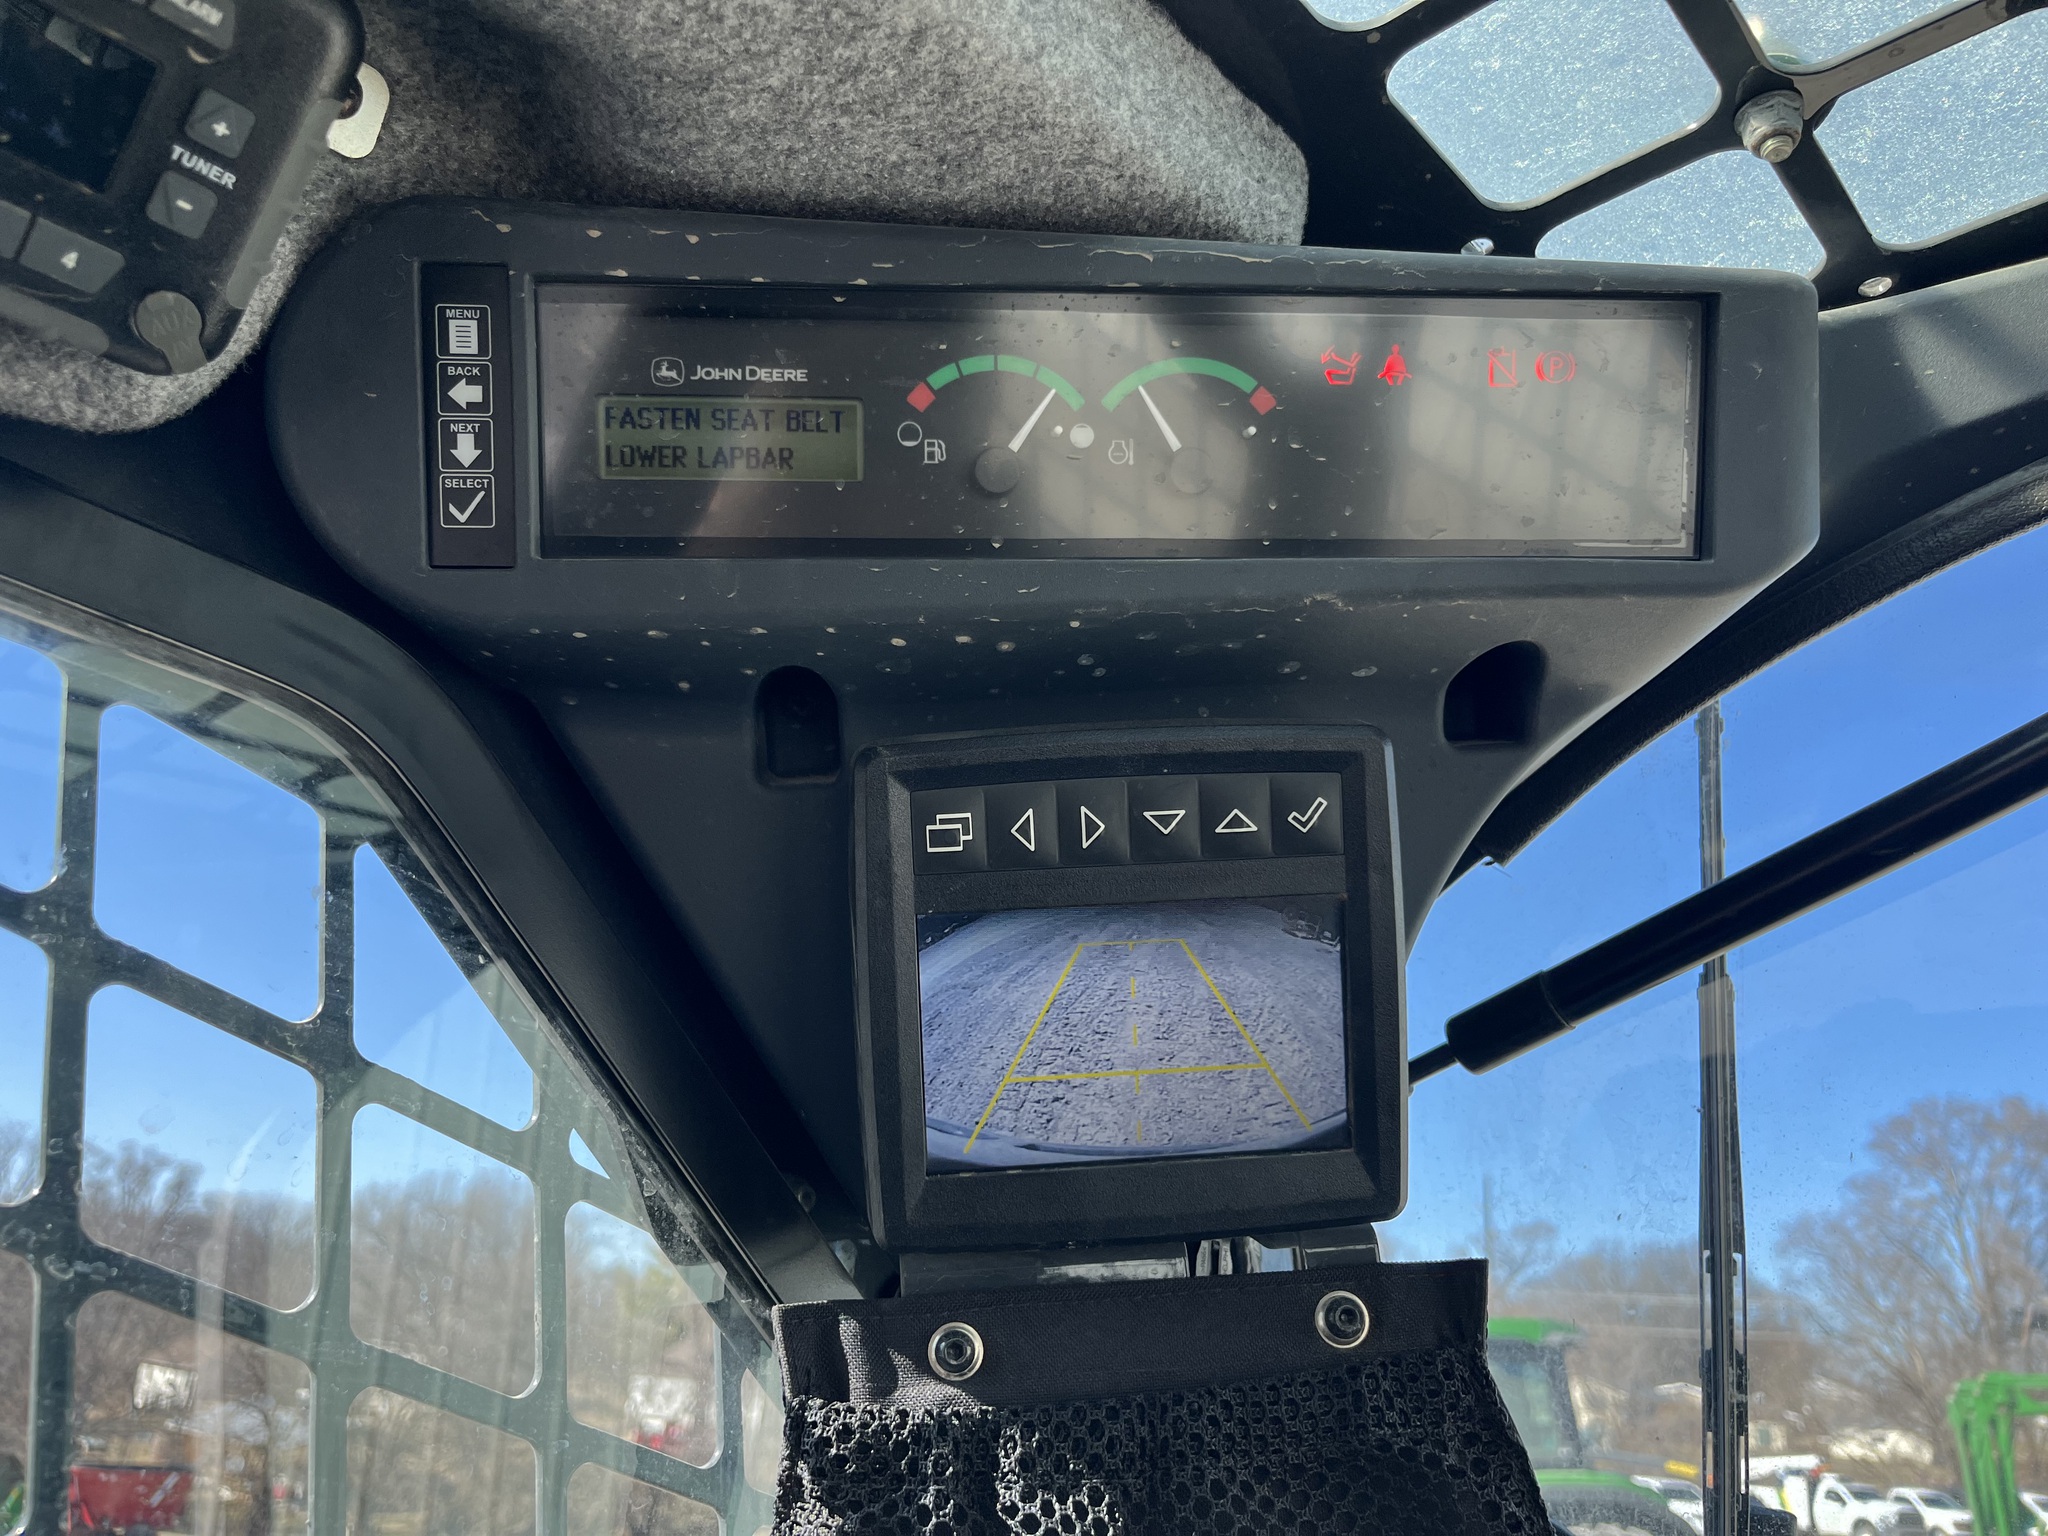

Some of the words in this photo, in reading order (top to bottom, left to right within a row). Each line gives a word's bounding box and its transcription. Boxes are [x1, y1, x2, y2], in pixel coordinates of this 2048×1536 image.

[171, 145, 236, 190] TUNER
[60, 251, 78, 269] 4
[445, 308, 480, 319] MENU
[447, 365, 481, 376] BACK
[690, 364, 742, 381] JOHN
[745, 365, 809, 382] DEERE
[450, 423, 481, 433] NEXT
[604, 406, 701, 431] FASTEN
[711, 408, 775, 431] SEAT
[786, 409, 846, 434] BELT
[605, 444, 687, 469] LOWER
[698, 446, 795, 470] LAPBAR
[444, 478, 489, 489] SELECT
